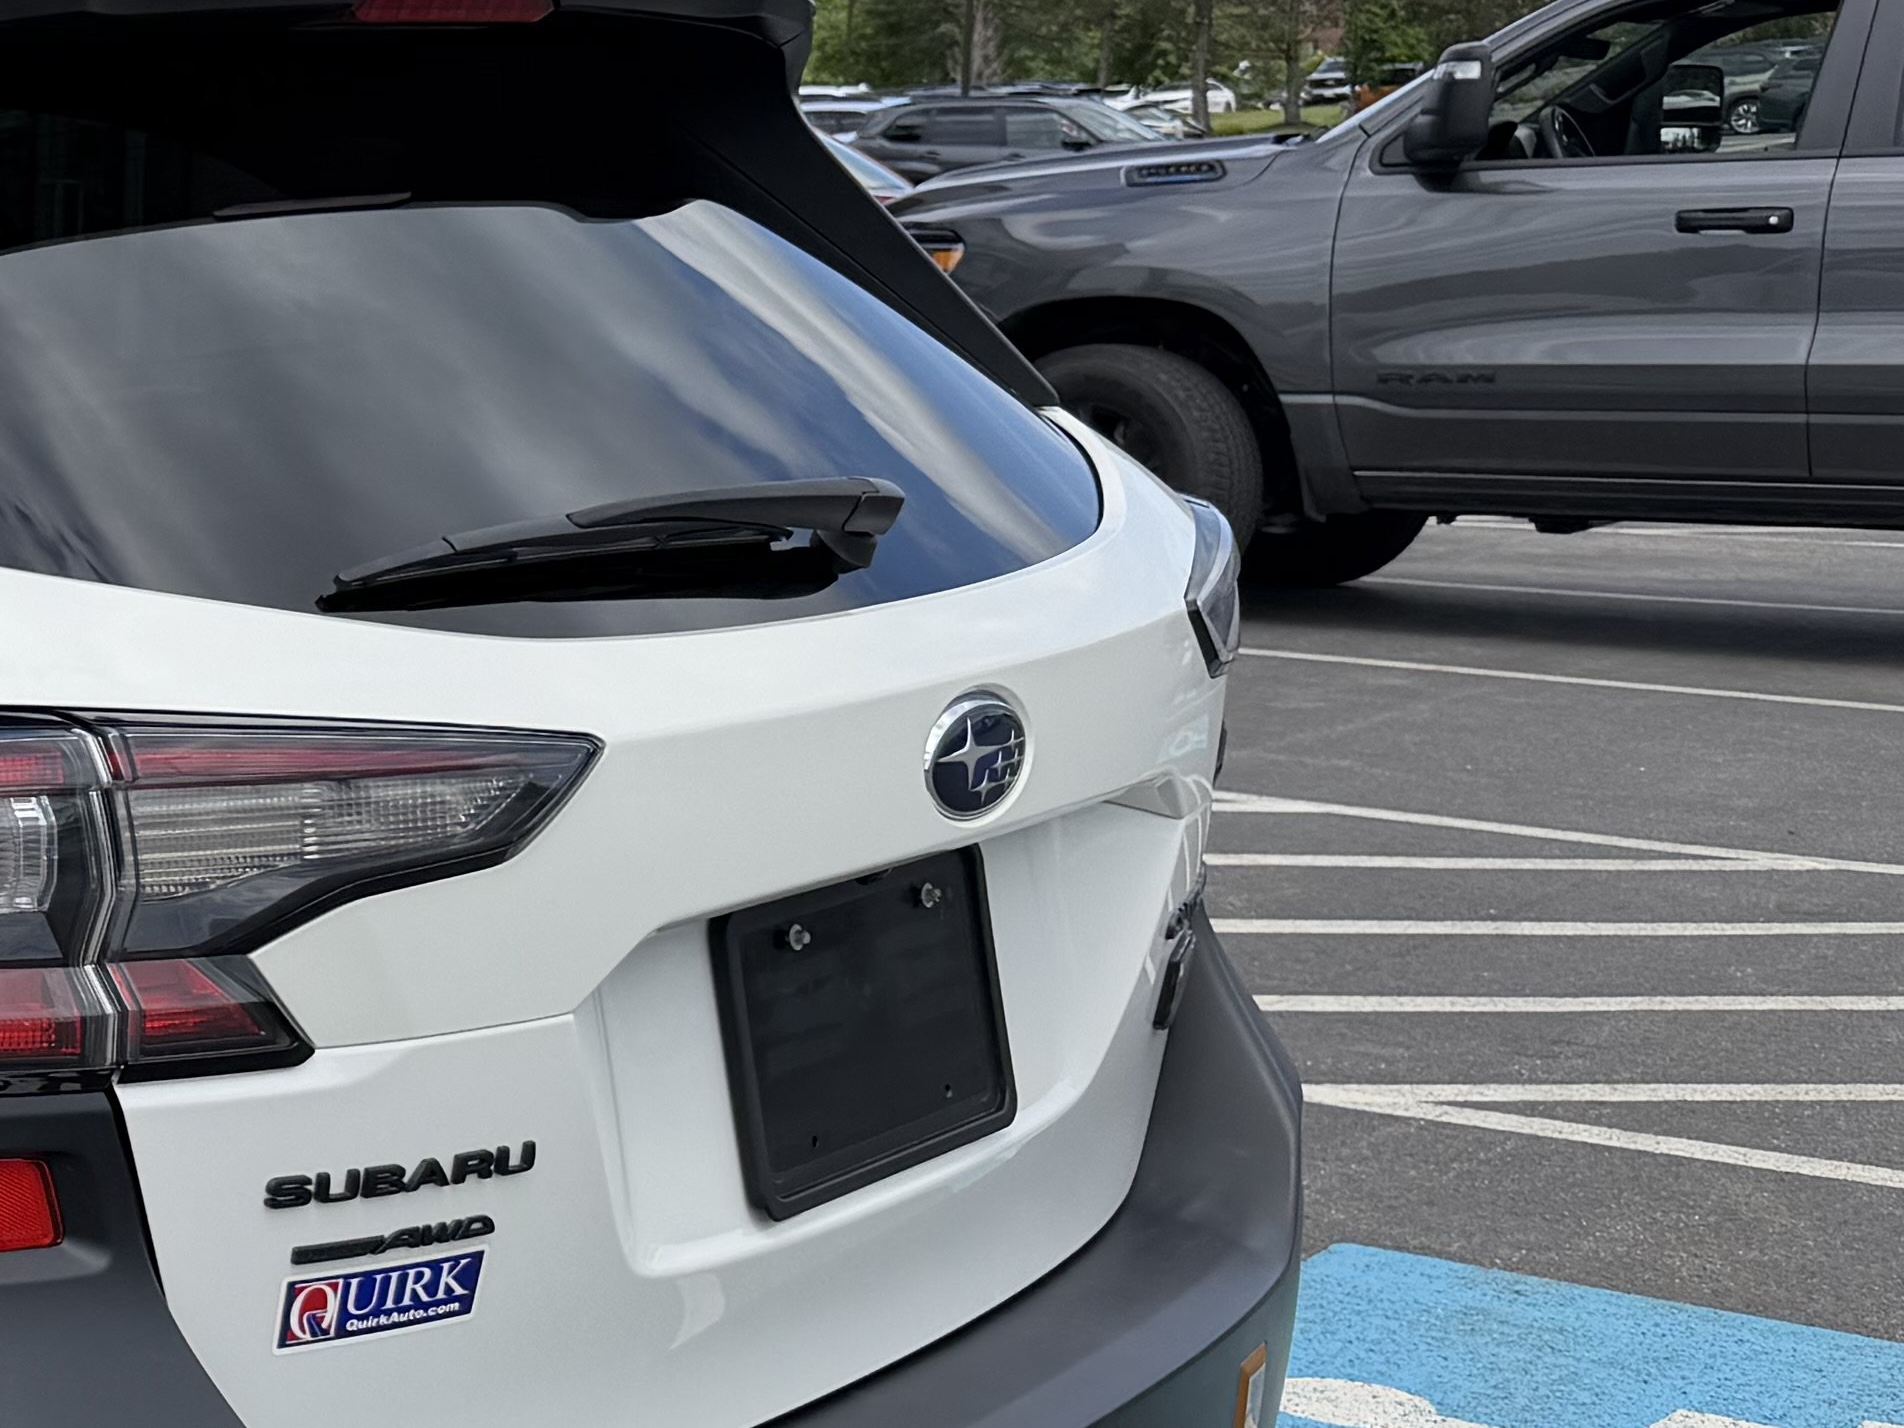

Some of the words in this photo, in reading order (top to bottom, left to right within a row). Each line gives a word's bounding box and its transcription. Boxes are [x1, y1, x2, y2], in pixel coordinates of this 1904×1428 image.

[1376, 372, 1496, 386] RAM
[263, 1139, 537, 1210] SUBARU
[374, 1213, 496, 1256] AWD
[290, 1257, 473, 1341] QUIRK
[345, 1301, 460, 1332] QuirkAuto.com
